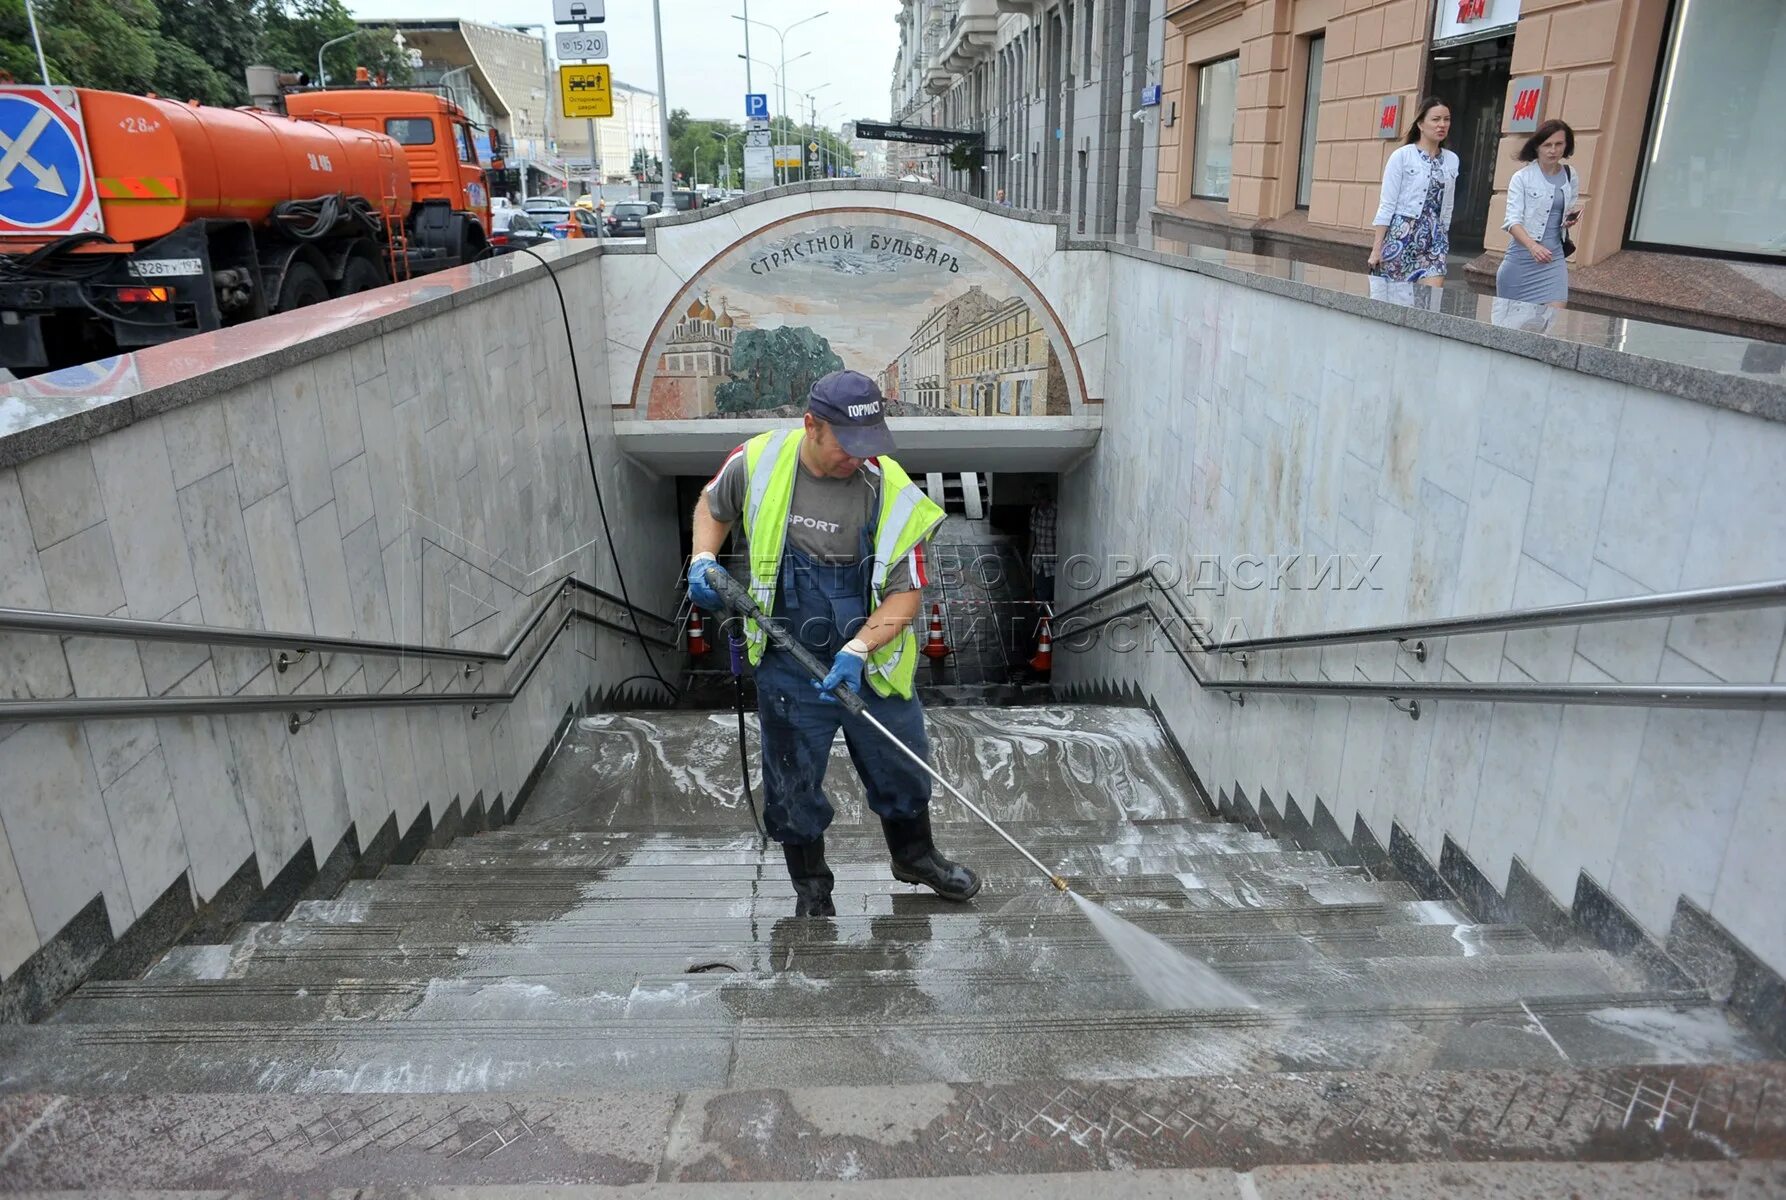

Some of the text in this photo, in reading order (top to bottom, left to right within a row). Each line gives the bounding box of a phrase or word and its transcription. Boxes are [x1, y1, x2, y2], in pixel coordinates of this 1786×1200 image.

[562, 39, 601, 51] 10 15 20
[750, 96, 764, 115] P
[750, 231, 960, 275] СТРАСТНОЙ БУЛЬВАРЪ
